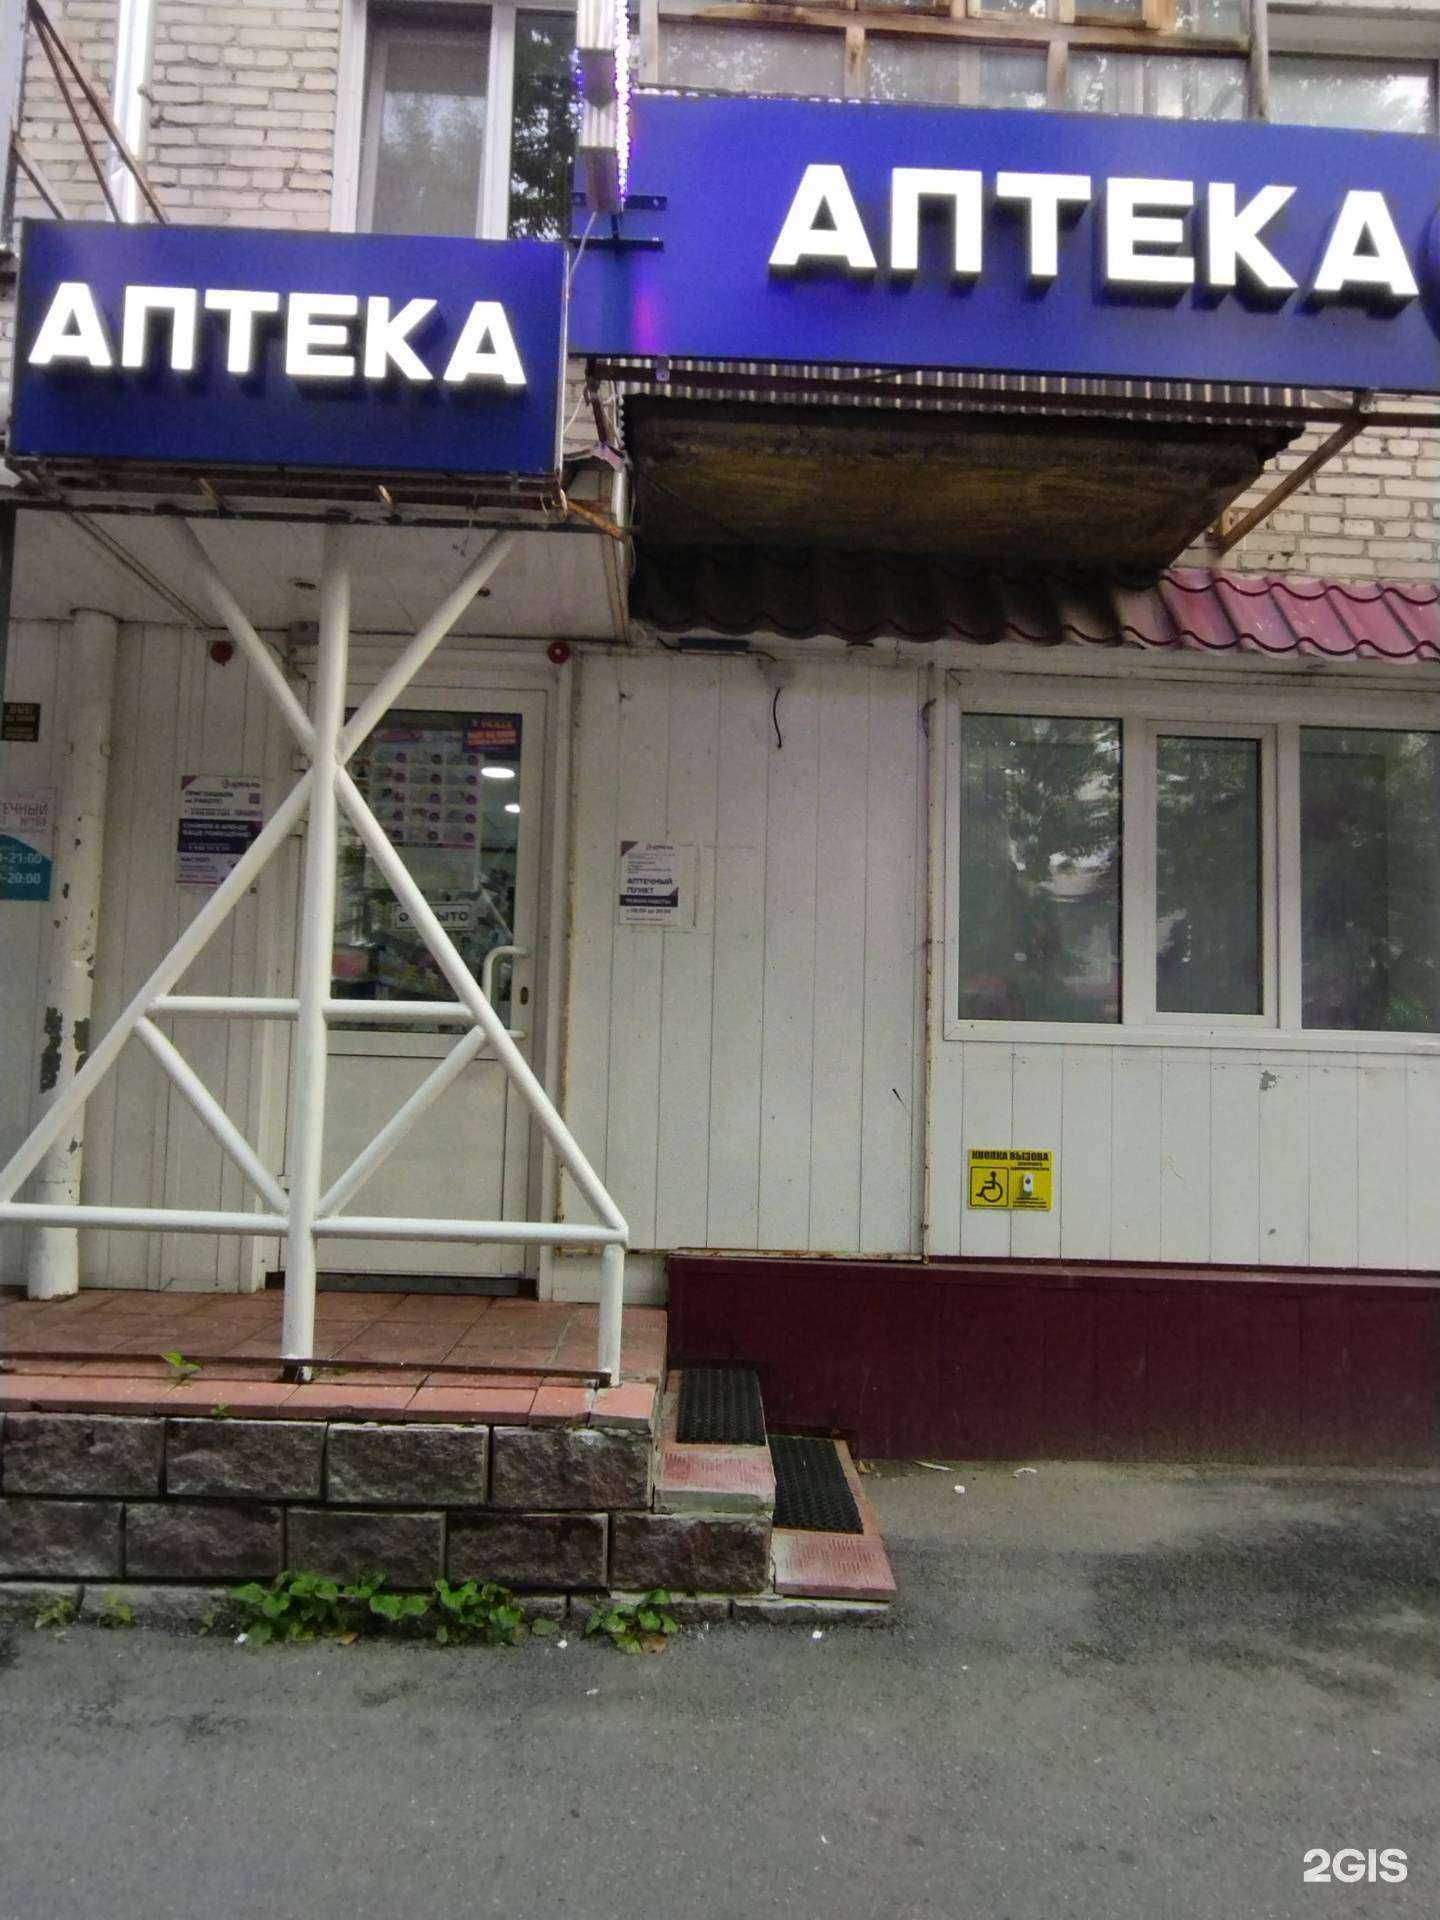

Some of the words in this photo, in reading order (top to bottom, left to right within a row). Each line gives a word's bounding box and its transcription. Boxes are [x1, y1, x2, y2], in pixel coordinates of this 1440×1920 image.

[768, 162, 1420, 300] АПТЕКА
[28, 281, 528, 386] АПТЕКА
[0, 801, 49, 816] ЕЧНЫЙ
[0, 853, 42, 864] -21:00
[0, 872, 42, 884] -20:00
[398, 911, 469, 922] ОЫТО
[971, 1150, 1008, 1160] КНОПКА
[1009, 1151, 1049, 1162] ВЫЗОВА
